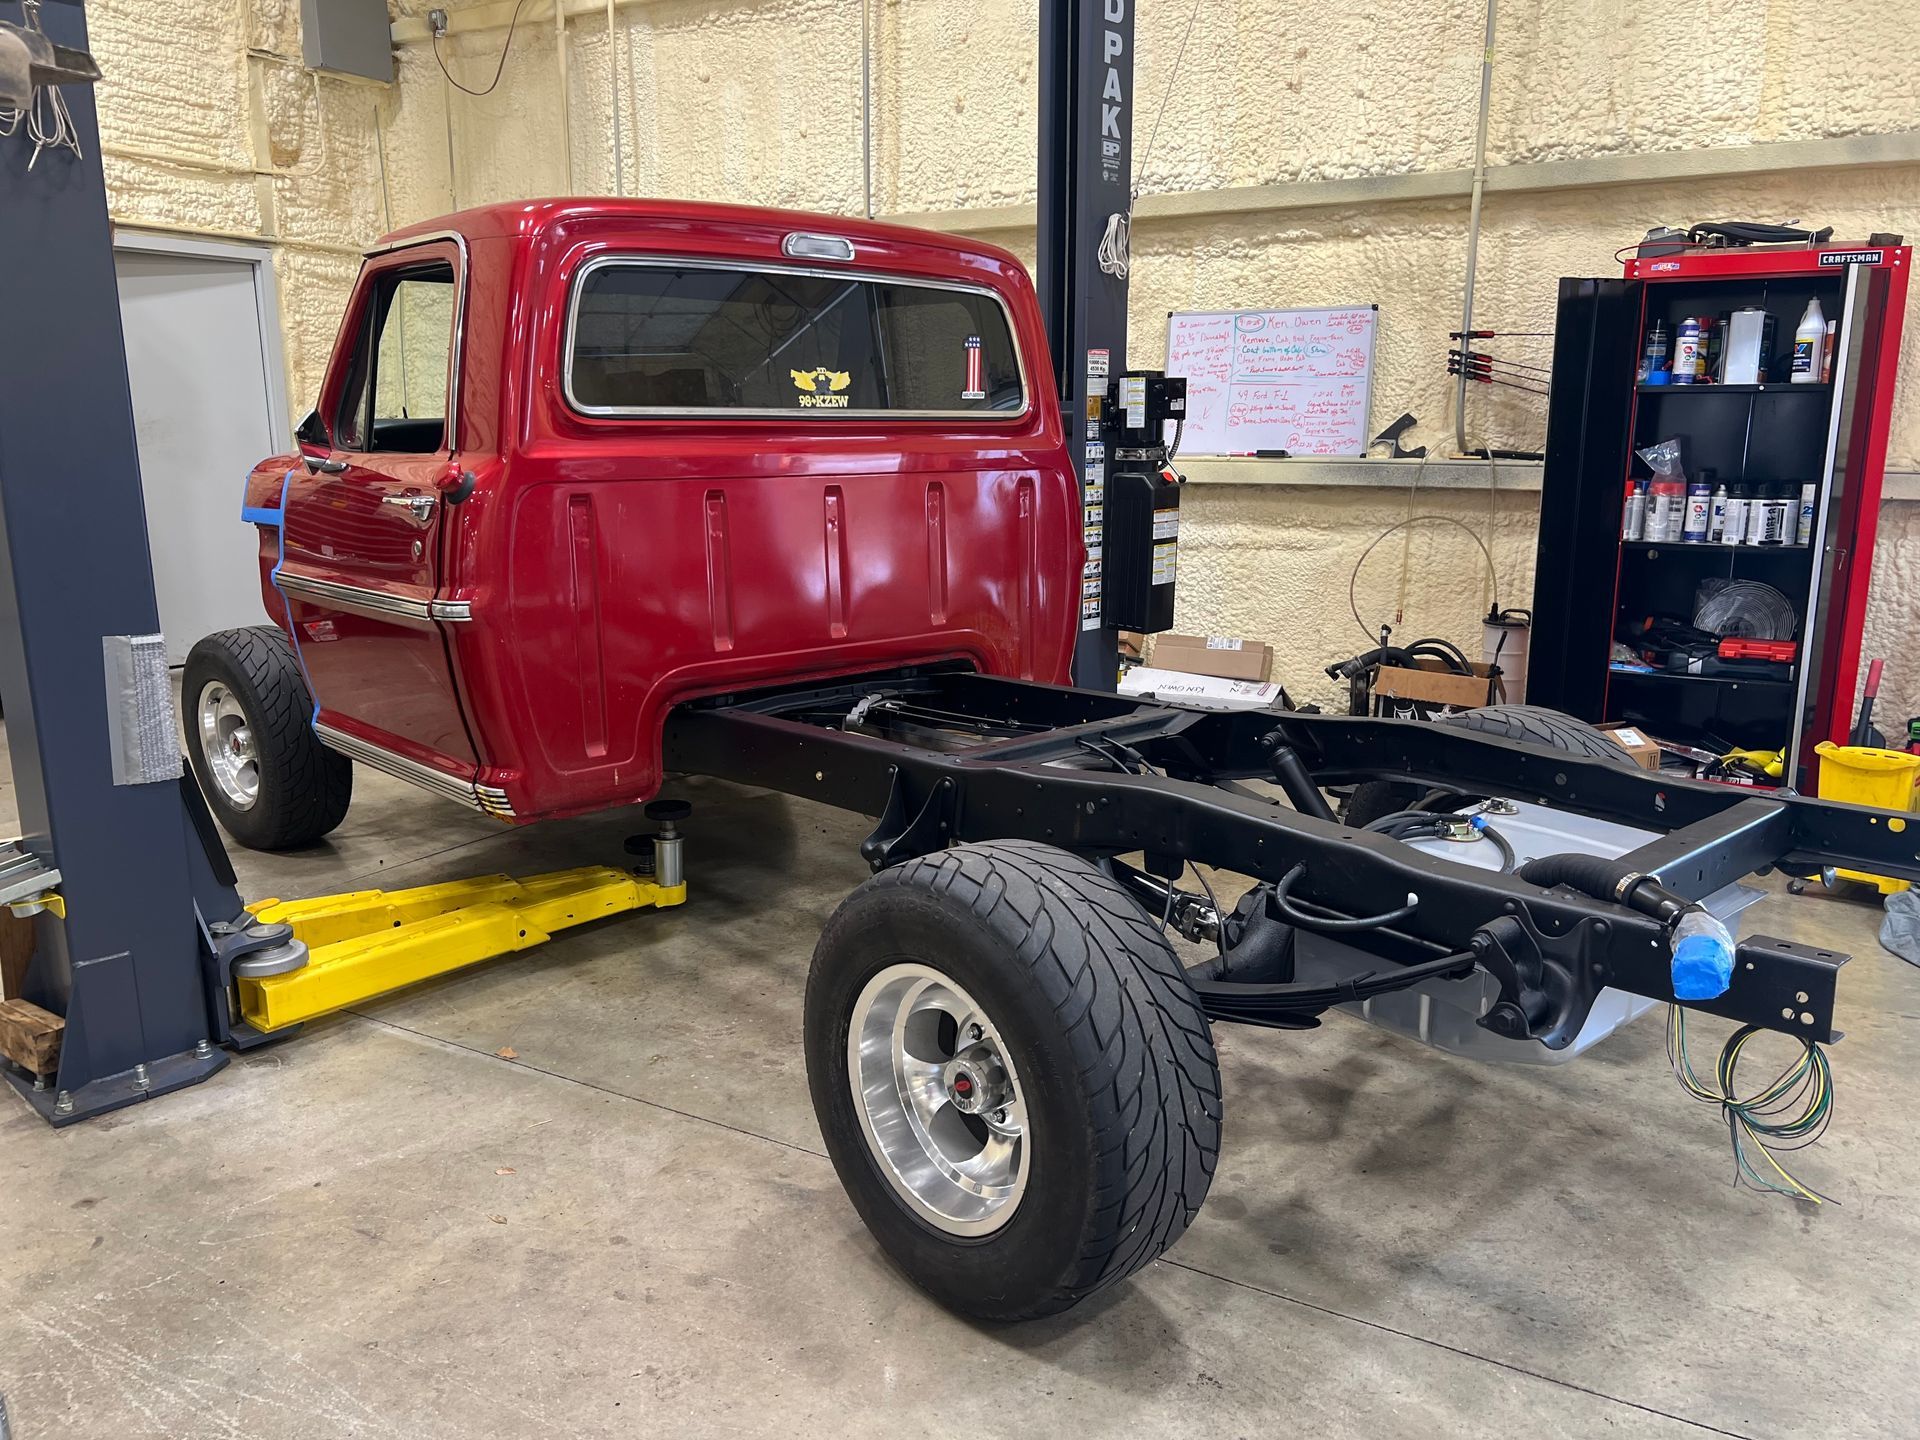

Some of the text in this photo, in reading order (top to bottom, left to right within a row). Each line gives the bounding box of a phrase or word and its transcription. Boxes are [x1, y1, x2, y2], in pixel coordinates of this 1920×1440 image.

[1823, 253, 1879, 264] CRAFTSMAN
[1267, 316, 1289, 329] Ken
[1294, 316, 1322, 328] Owen
[1186, 684, 1205, 694] KEN
